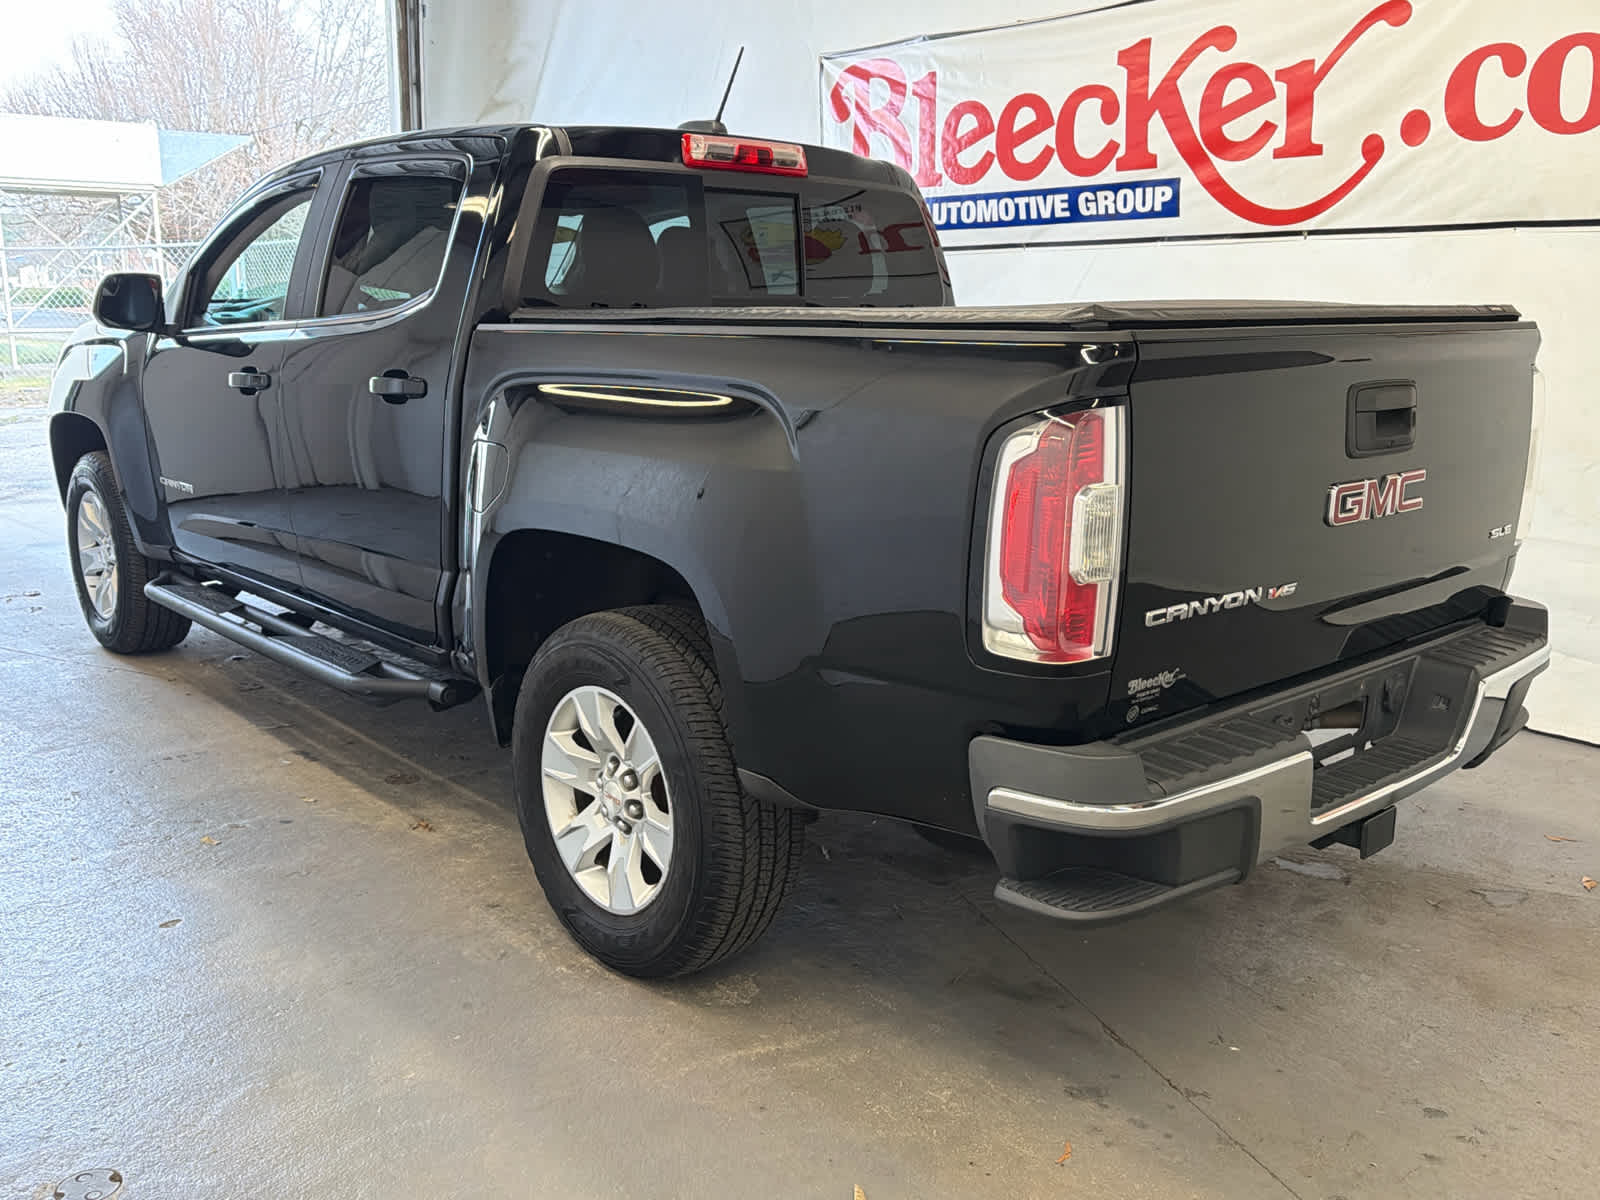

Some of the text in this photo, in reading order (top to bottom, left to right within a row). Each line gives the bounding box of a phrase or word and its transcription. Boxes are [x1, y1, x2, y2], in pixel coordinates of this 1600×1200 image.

[927, 186, 1173, 226] UTOMOTIVE GROUP
[1326, 469, 1426, 526] GMC
[1145, 582, 1297, 627] CANYON V6
